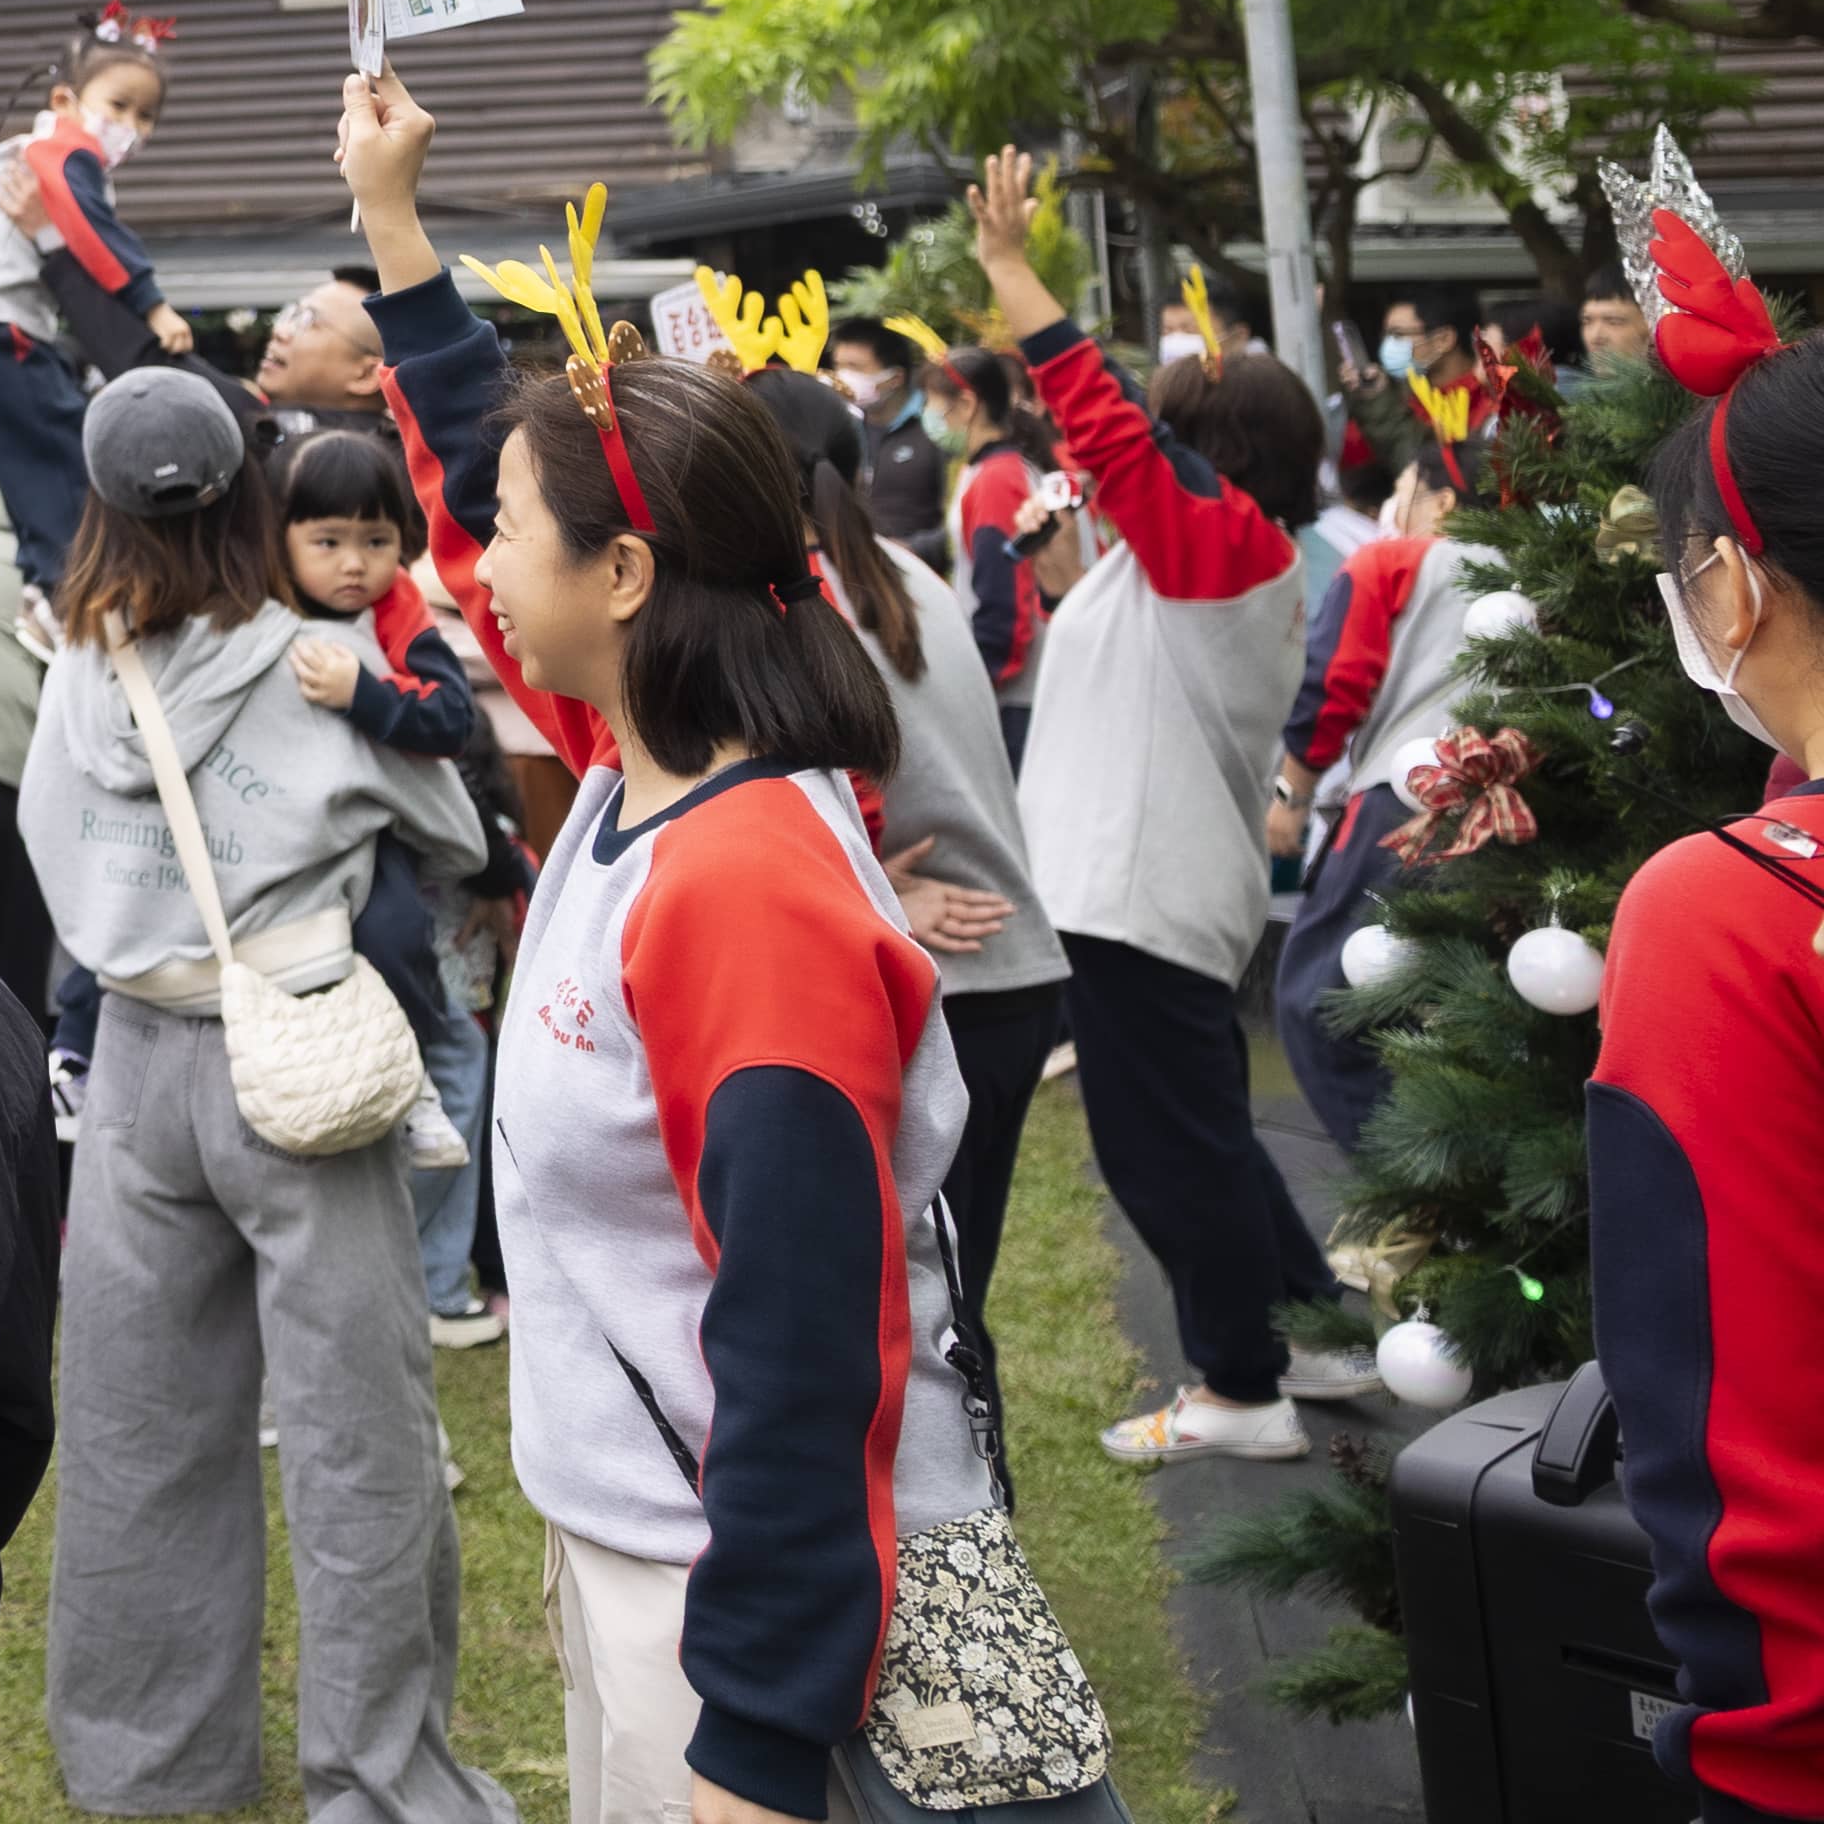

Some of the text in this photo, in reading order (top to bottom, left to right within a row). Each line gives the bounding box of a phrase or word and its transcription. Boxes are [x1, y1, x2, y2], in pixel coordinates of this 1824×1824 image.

[206, 742, 269, 805] nce
[80, 808, 177, 860] Running
[104, 858, 152, 889] Since
